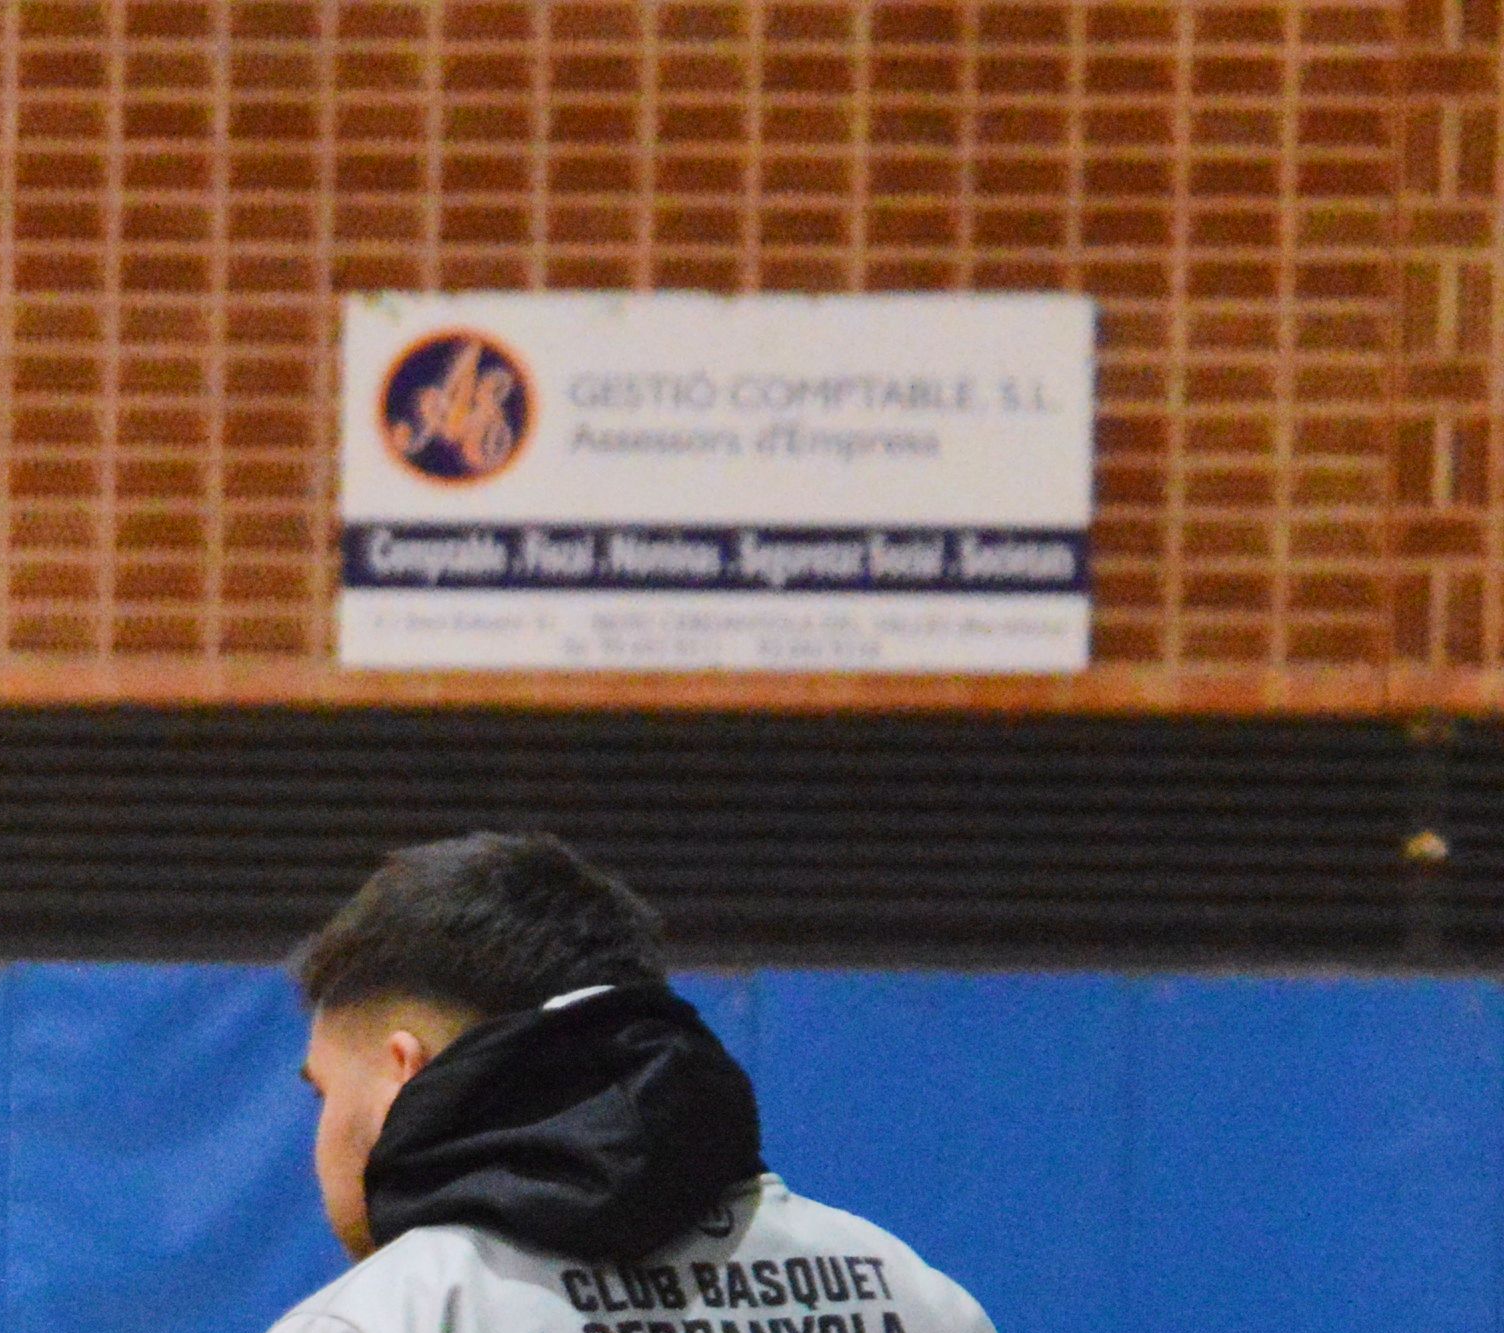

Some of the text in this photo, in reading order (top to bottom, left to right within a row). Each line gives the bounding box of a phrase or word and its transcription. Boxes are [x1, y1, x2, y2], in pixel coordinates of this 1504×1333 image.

[571, 422, 743, 457] Assessors
[561, 1255, 894, 1312] CLUB BASQUET
